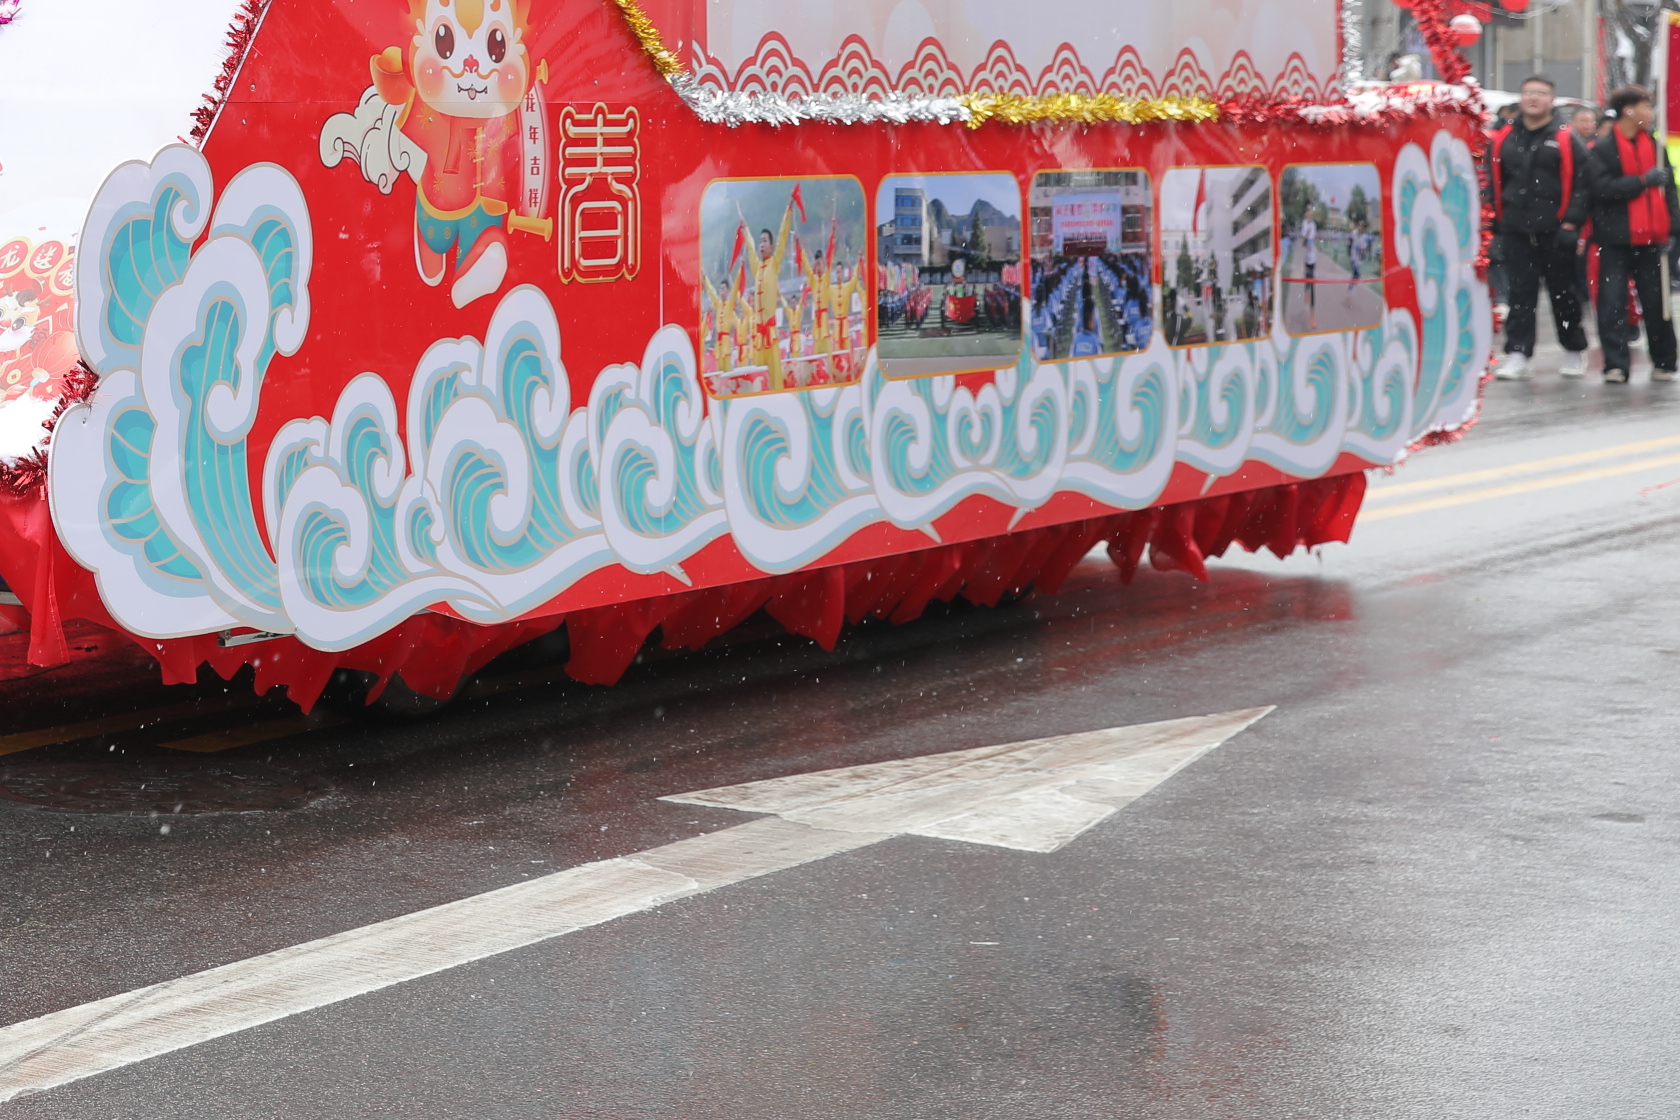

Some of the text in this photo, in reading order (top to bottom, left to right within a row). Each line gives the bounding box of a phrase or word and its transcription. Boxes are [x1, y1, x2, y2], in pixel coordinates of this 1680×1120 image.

[525, 93, 541, 208] 龙年吉祥
[559, 103, 641, 283] 春
